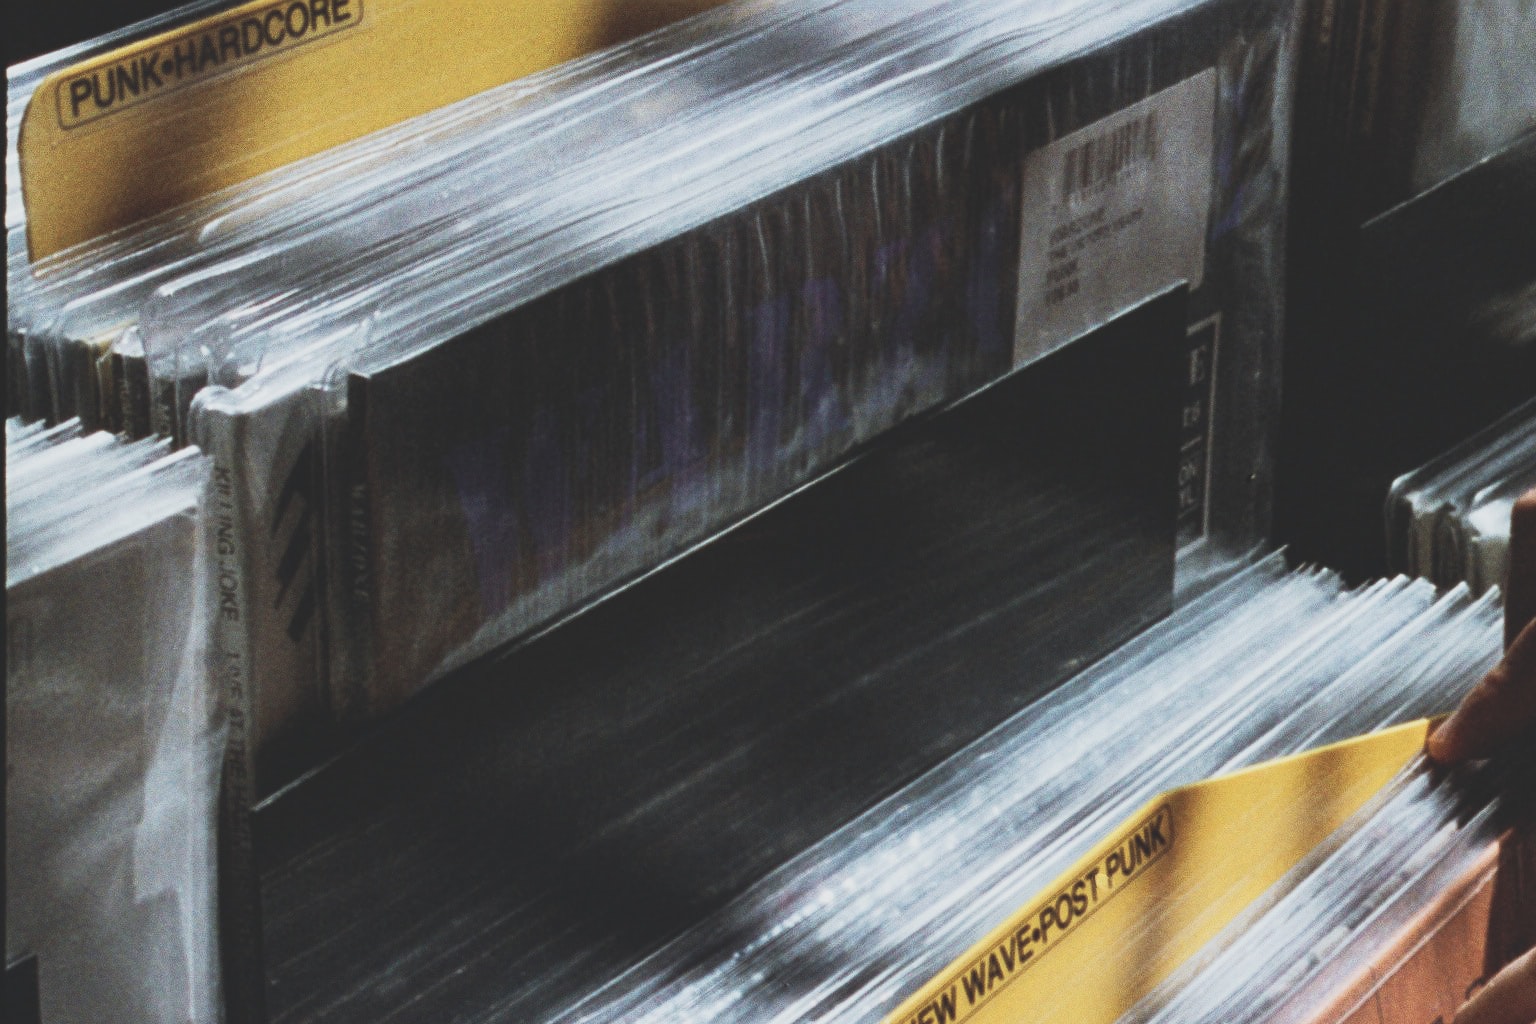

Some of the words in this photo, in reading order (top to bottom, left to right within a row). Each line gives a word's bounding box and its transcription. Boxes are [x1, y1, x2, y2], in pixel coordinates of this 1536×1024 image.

[213, 465, 236, 555] KILLING
[219, 560, 240, 621] JOKE
[1104, 813, 1166, 889] PUNK
